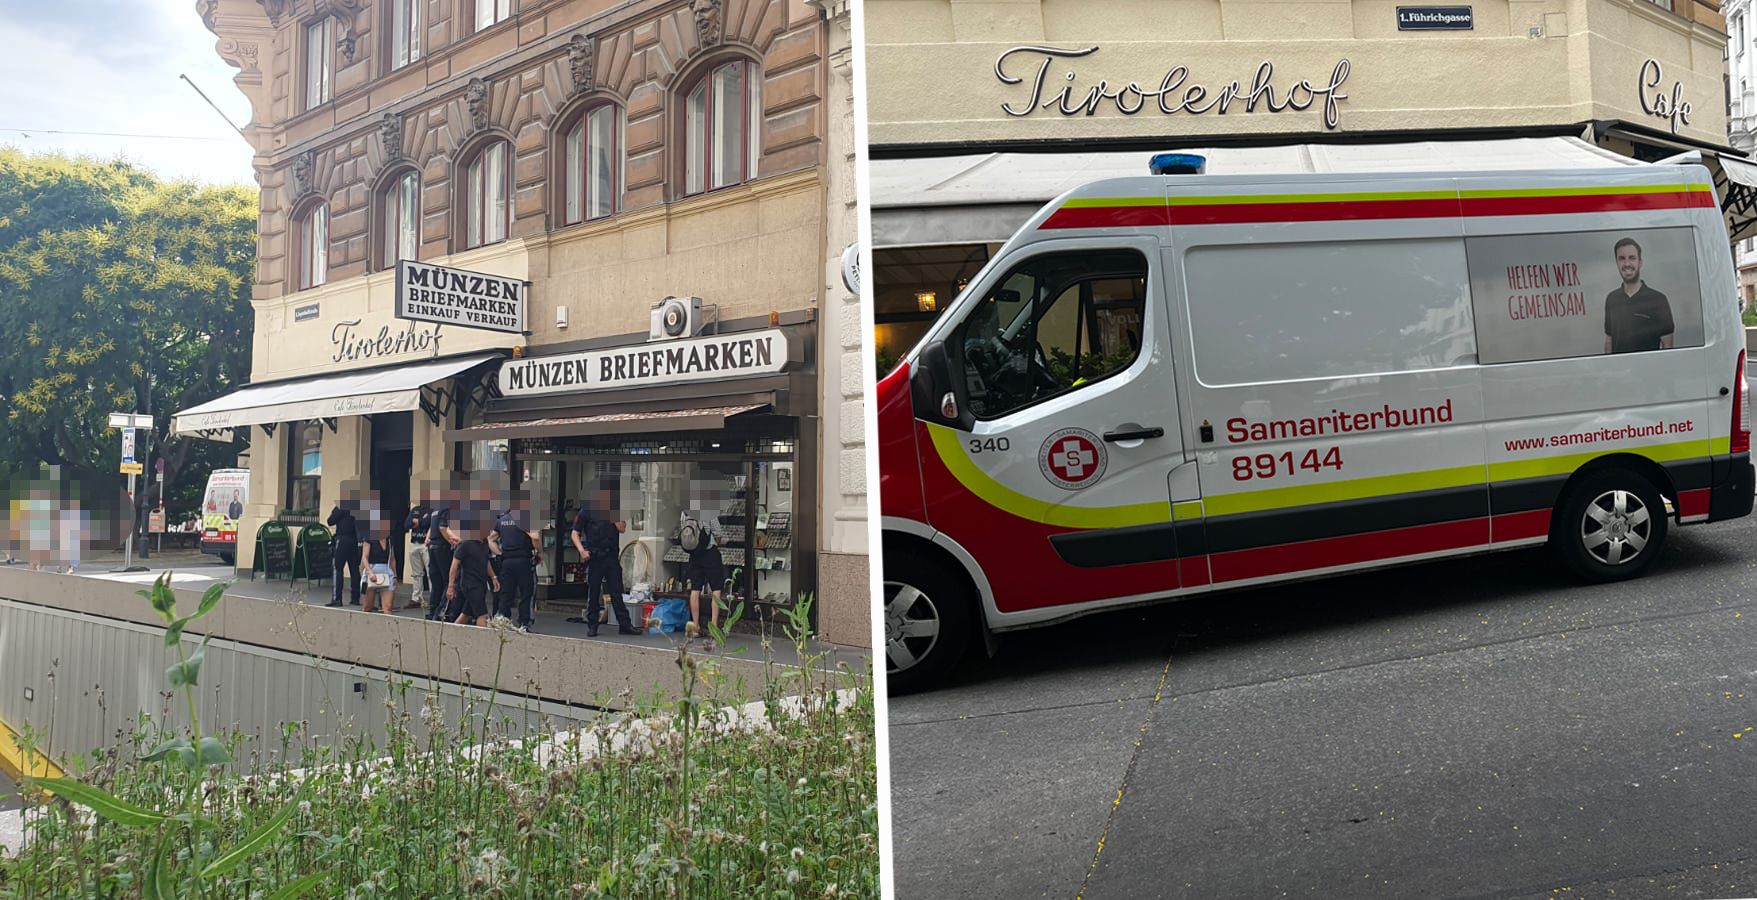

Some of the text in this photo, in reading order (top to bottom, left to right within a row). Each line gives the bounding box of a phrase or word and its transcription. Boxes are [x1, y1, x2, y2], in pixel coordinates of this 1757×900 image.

[994, 45, 1350, 129] Tirolerhof
[1638, 57, 1692, 135] Cafe
[407, 266, 519, 301] MÜNZEN
[1506, 263, 1581, 290] HELFEN WIR
[407, 303, 517, 327] EINKAUF VERKAUF
[409, 287, 516, 316] BRIEFMARKEN
[1508, 291, 1586, 321] GEMEINSAM
[332, 318, 443, 362] Tirolerhof
[509, 337, 773, 390] MÜNZEN BRIEFMARKEN
[1226, 399, 1453, 443] Samariterbund
[1505, 420, 1693, 451] www.samariterbund.net
[969, 437, 1010, 454] 340
[1066, 450, 1081, 467] S
[1232, 446, 1344, 481] 89144
